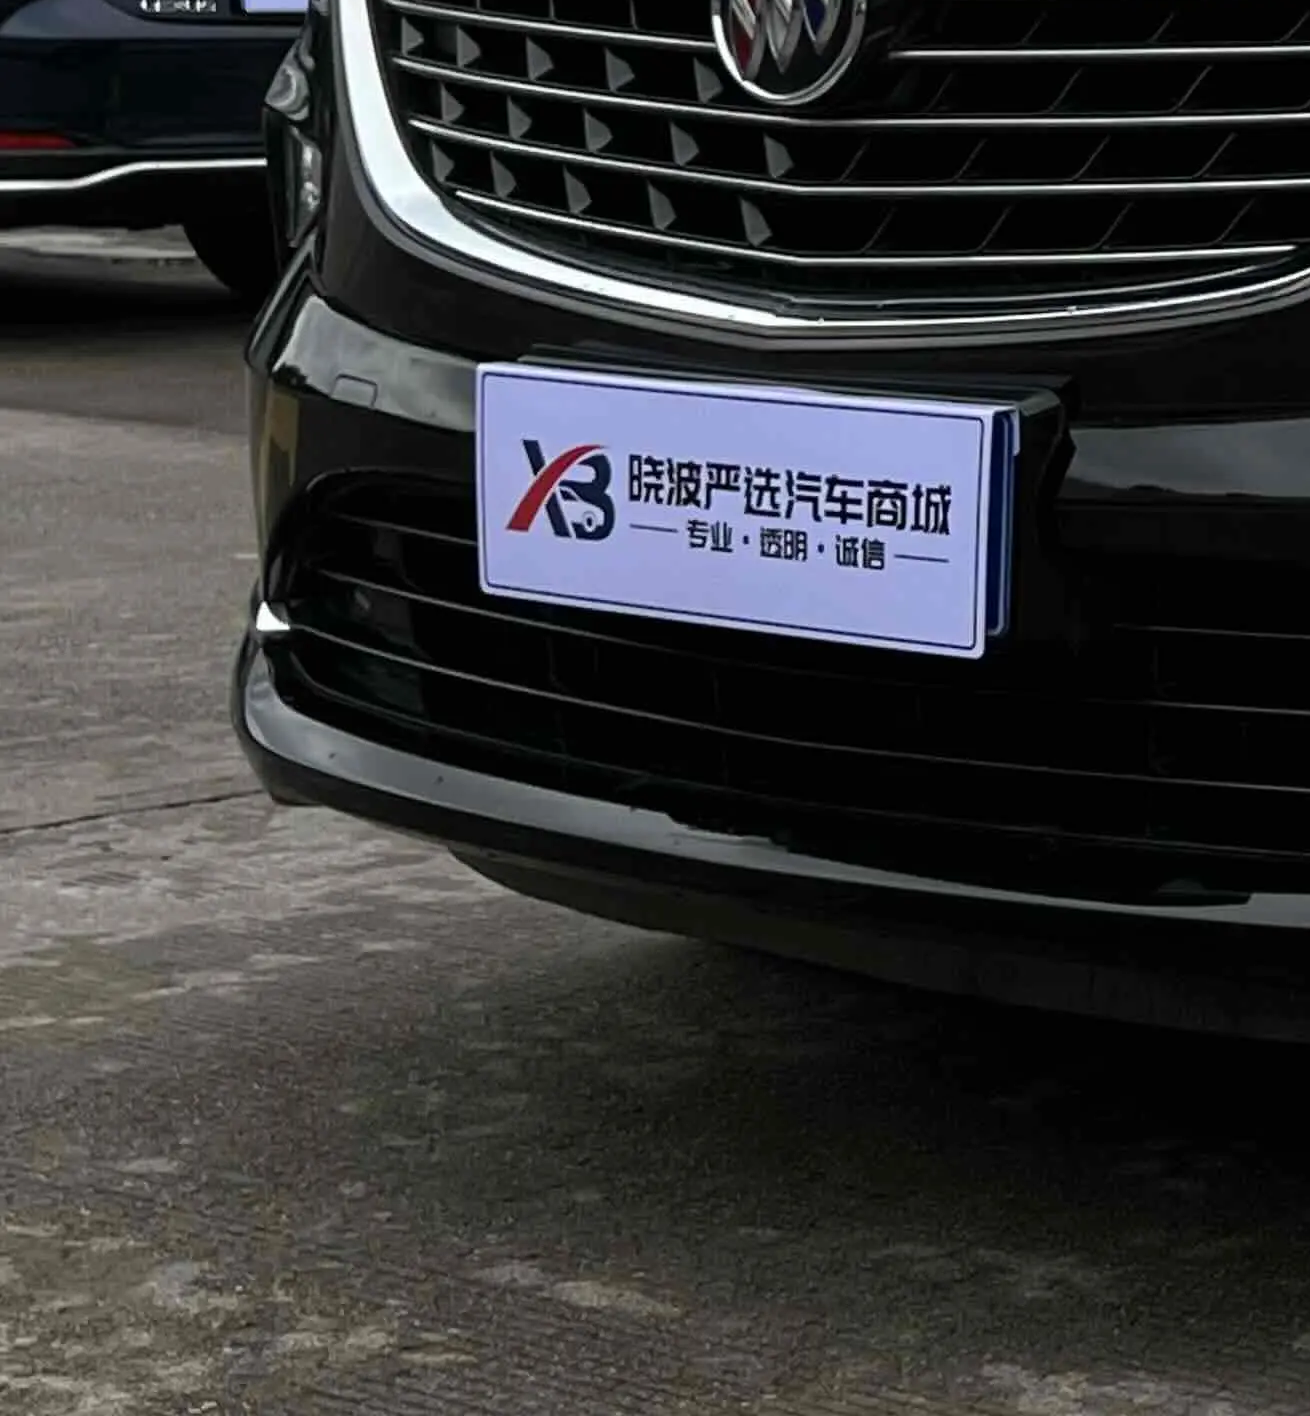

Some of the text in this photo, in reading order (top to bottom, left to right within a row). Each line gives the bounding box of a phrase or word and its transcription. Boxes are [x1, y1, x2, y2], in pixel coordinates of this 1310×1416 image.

[628, 453, 952, 536] 晓波严选汽车商城
